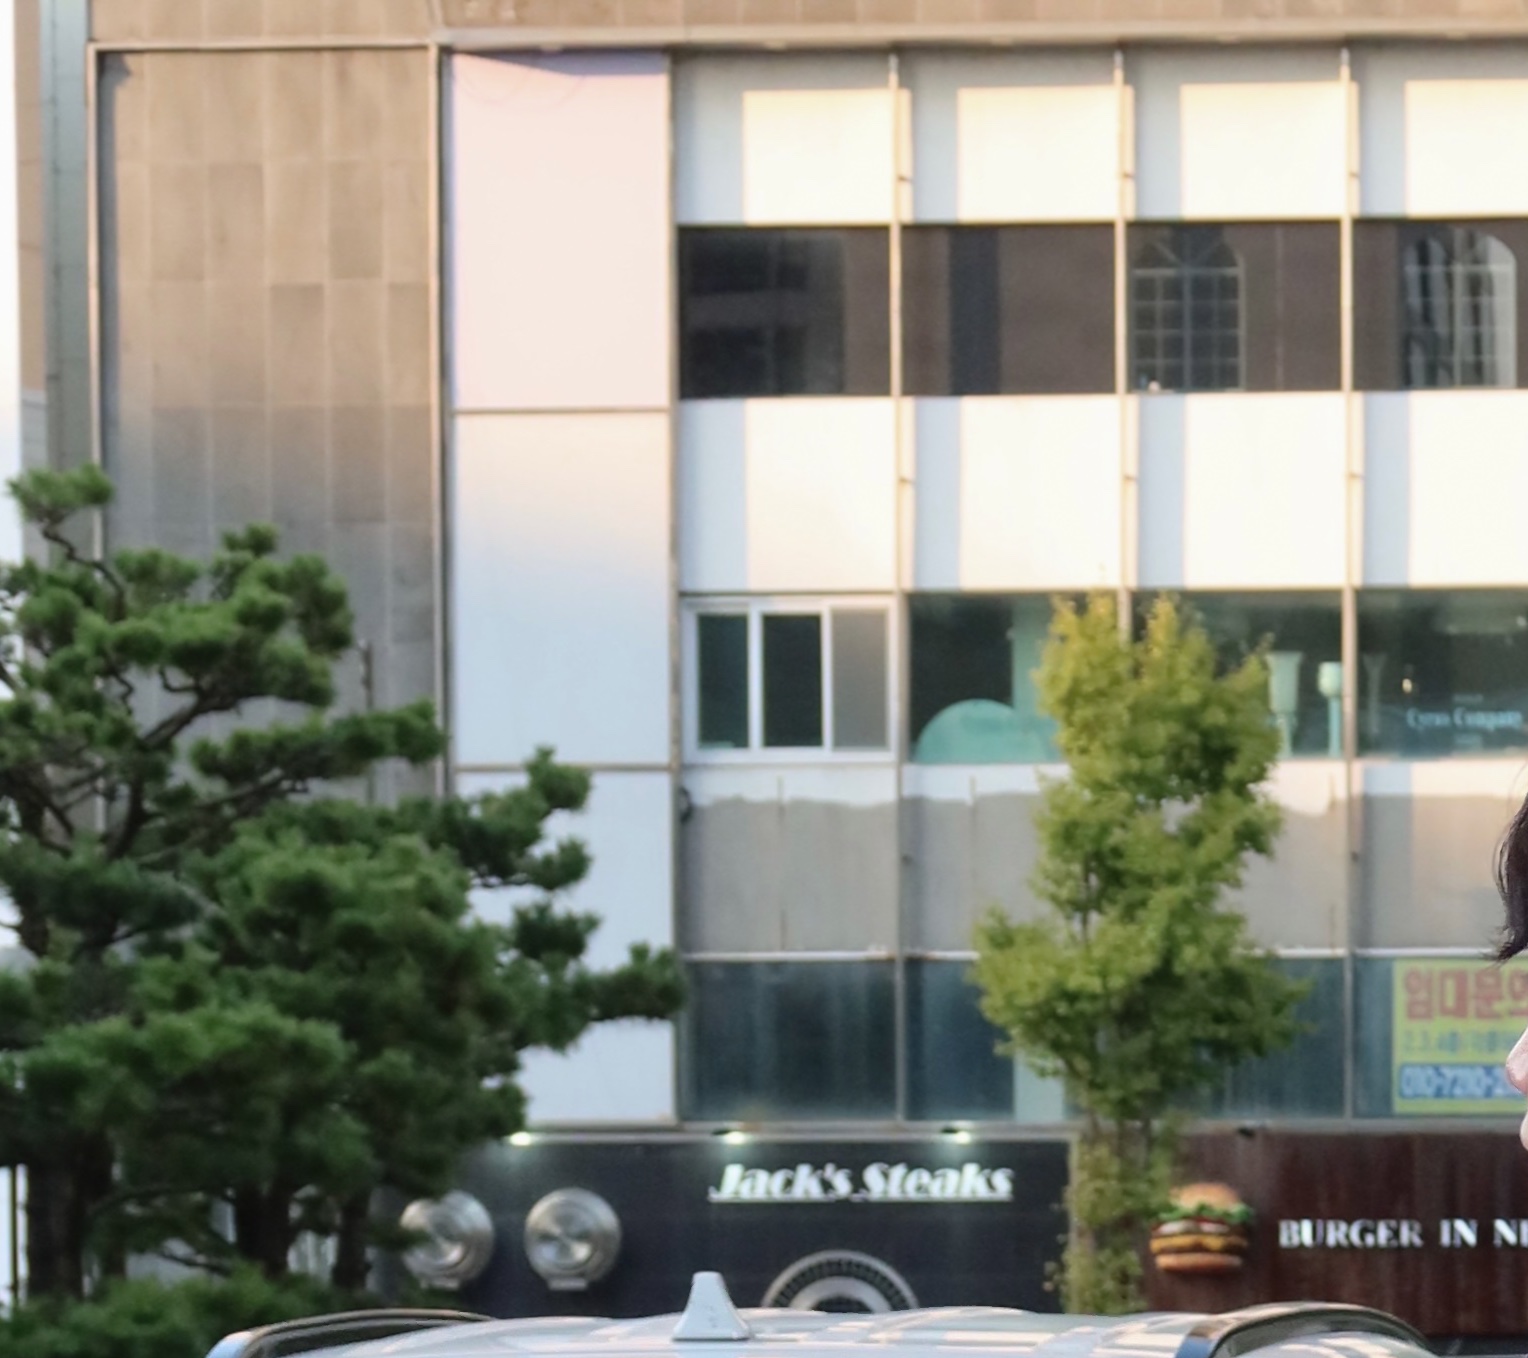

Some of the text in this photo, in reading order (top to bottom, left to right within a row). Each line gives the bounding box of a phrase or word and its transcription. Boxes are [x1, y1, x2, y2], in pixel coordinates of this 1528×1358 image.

[708, 1162, 1015, 1201] Jack's Steaks
[1278, 1218, 1424, 1248] BURGER
[1439, 1218, 1477, 1247] IN
